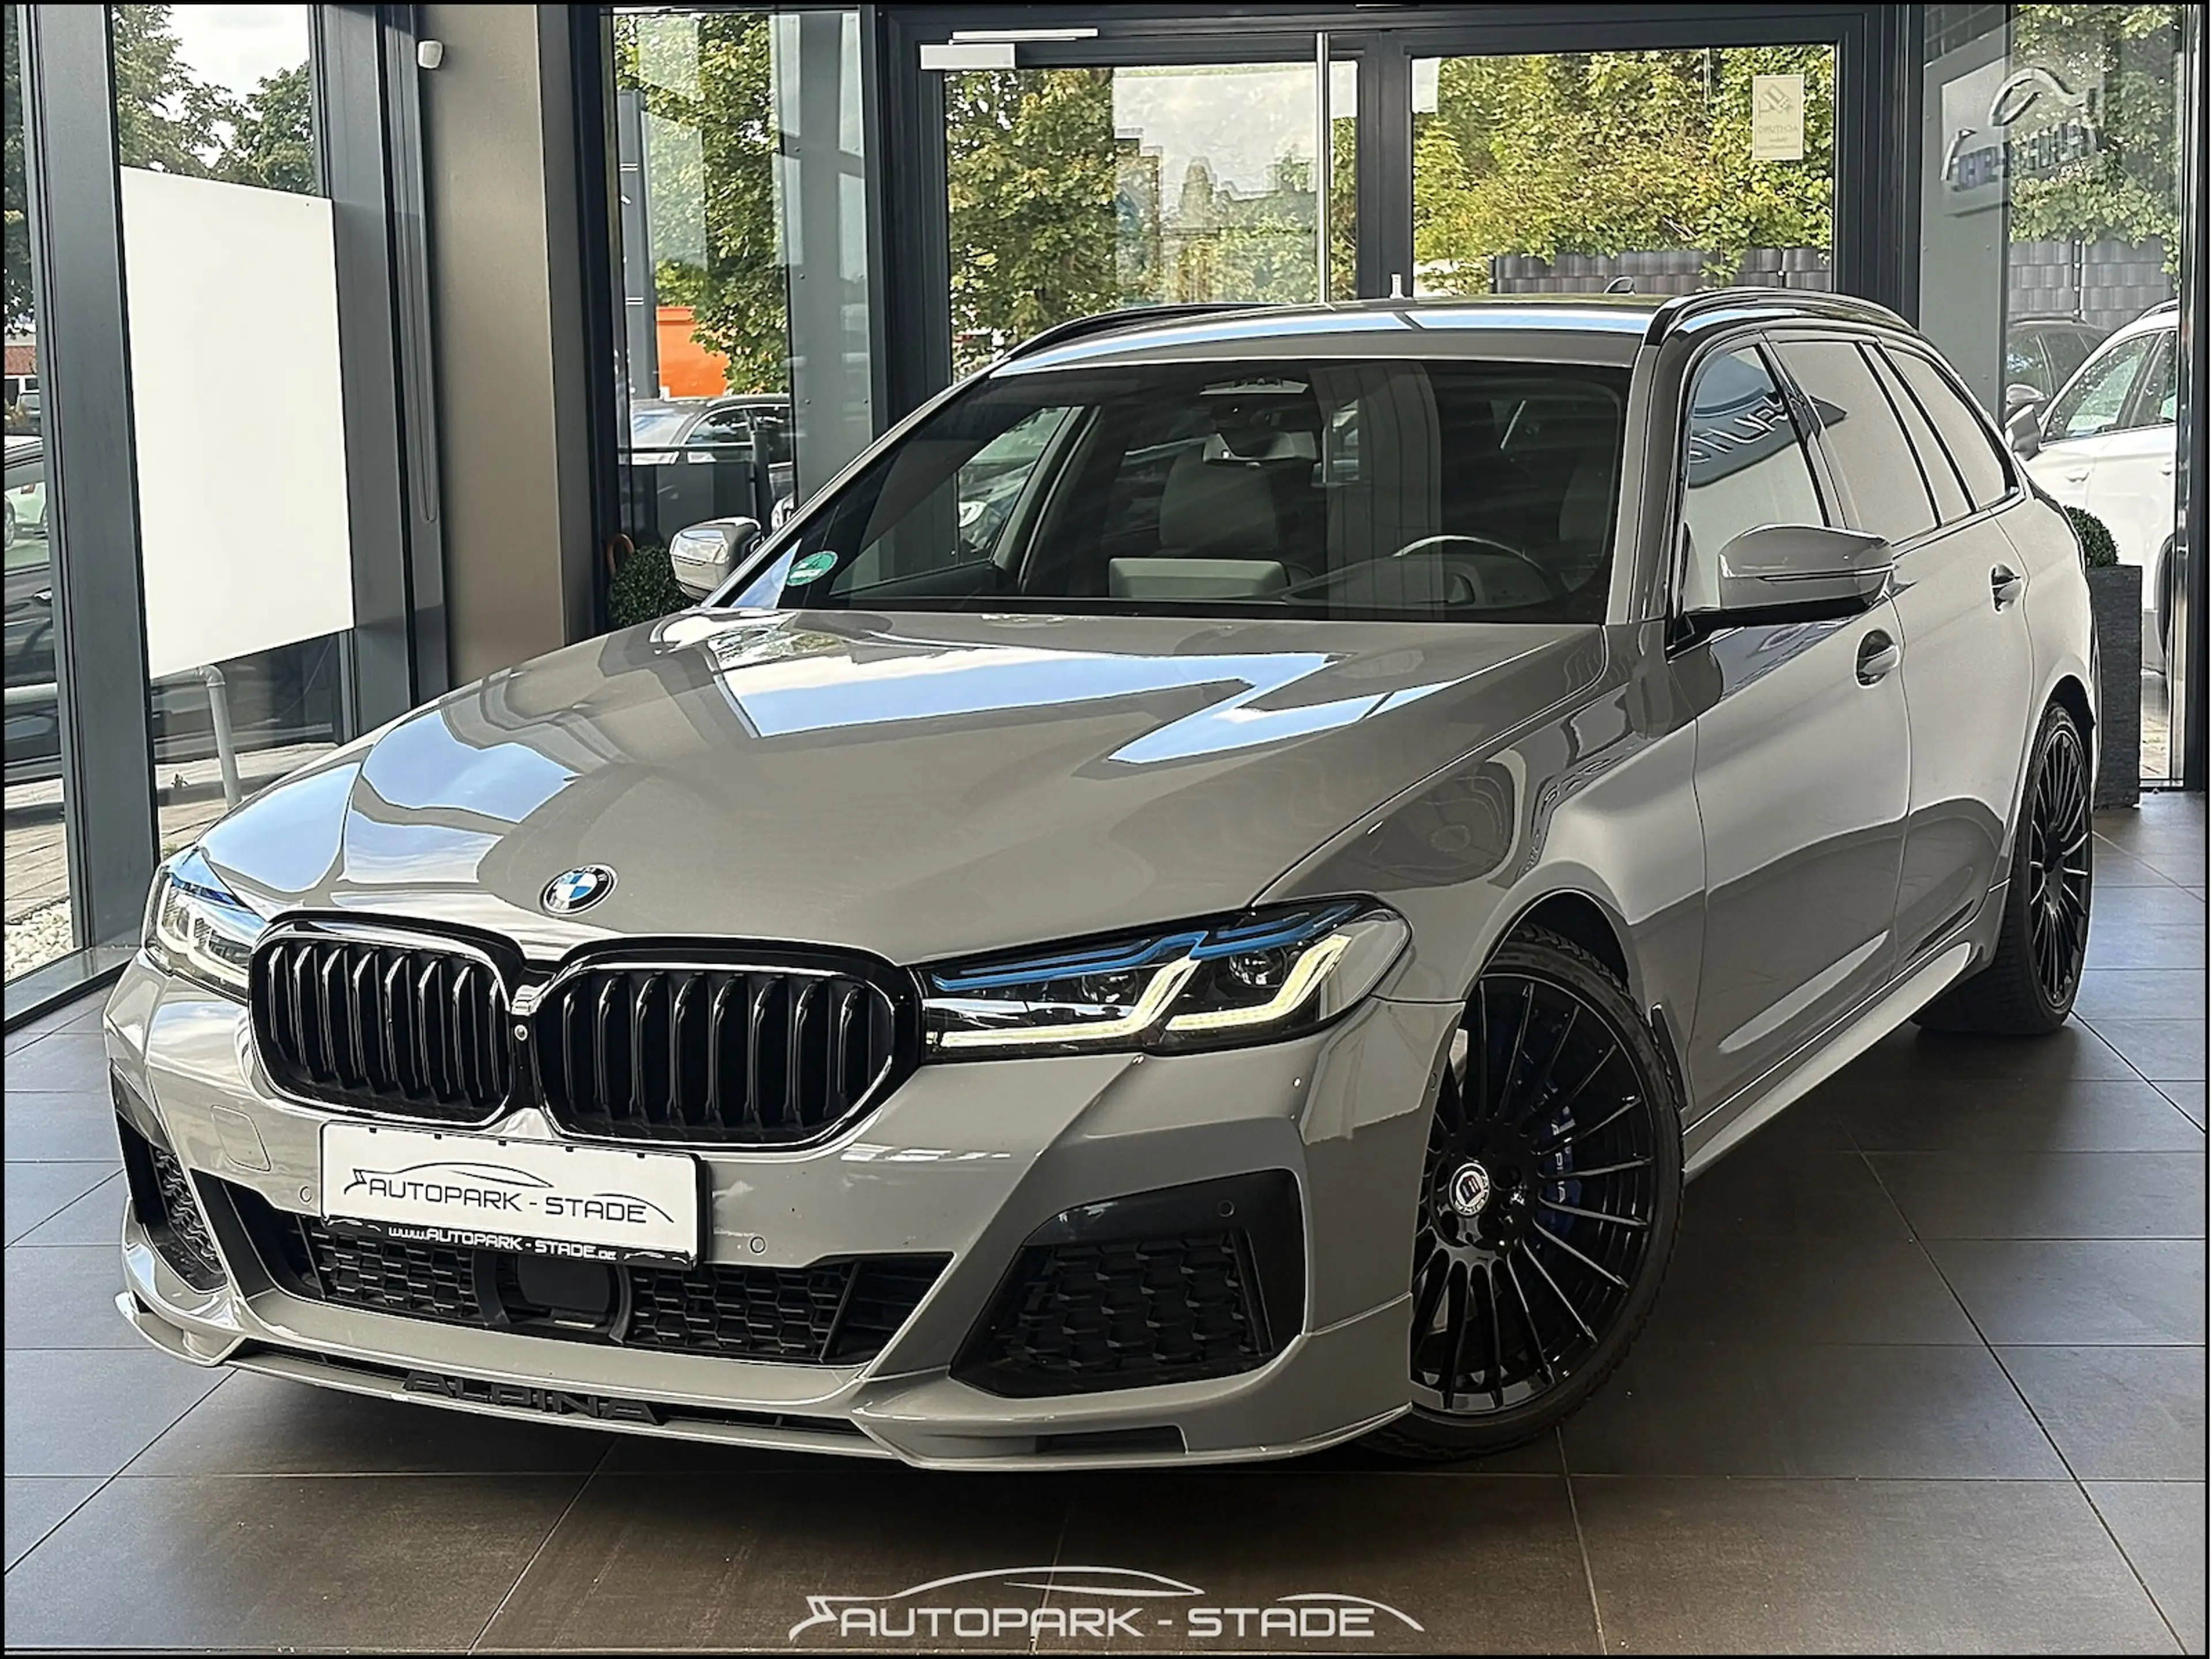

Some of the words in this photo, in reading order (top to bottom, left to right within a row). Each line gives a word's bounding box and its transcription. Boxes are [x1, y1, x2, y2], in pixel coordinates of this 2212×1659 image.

[369, 1178, 522, 1212] AUTOPARK
[546, 1196, 647, 1224] STADE
[403, 1370, 665, 1426] ALPINA
